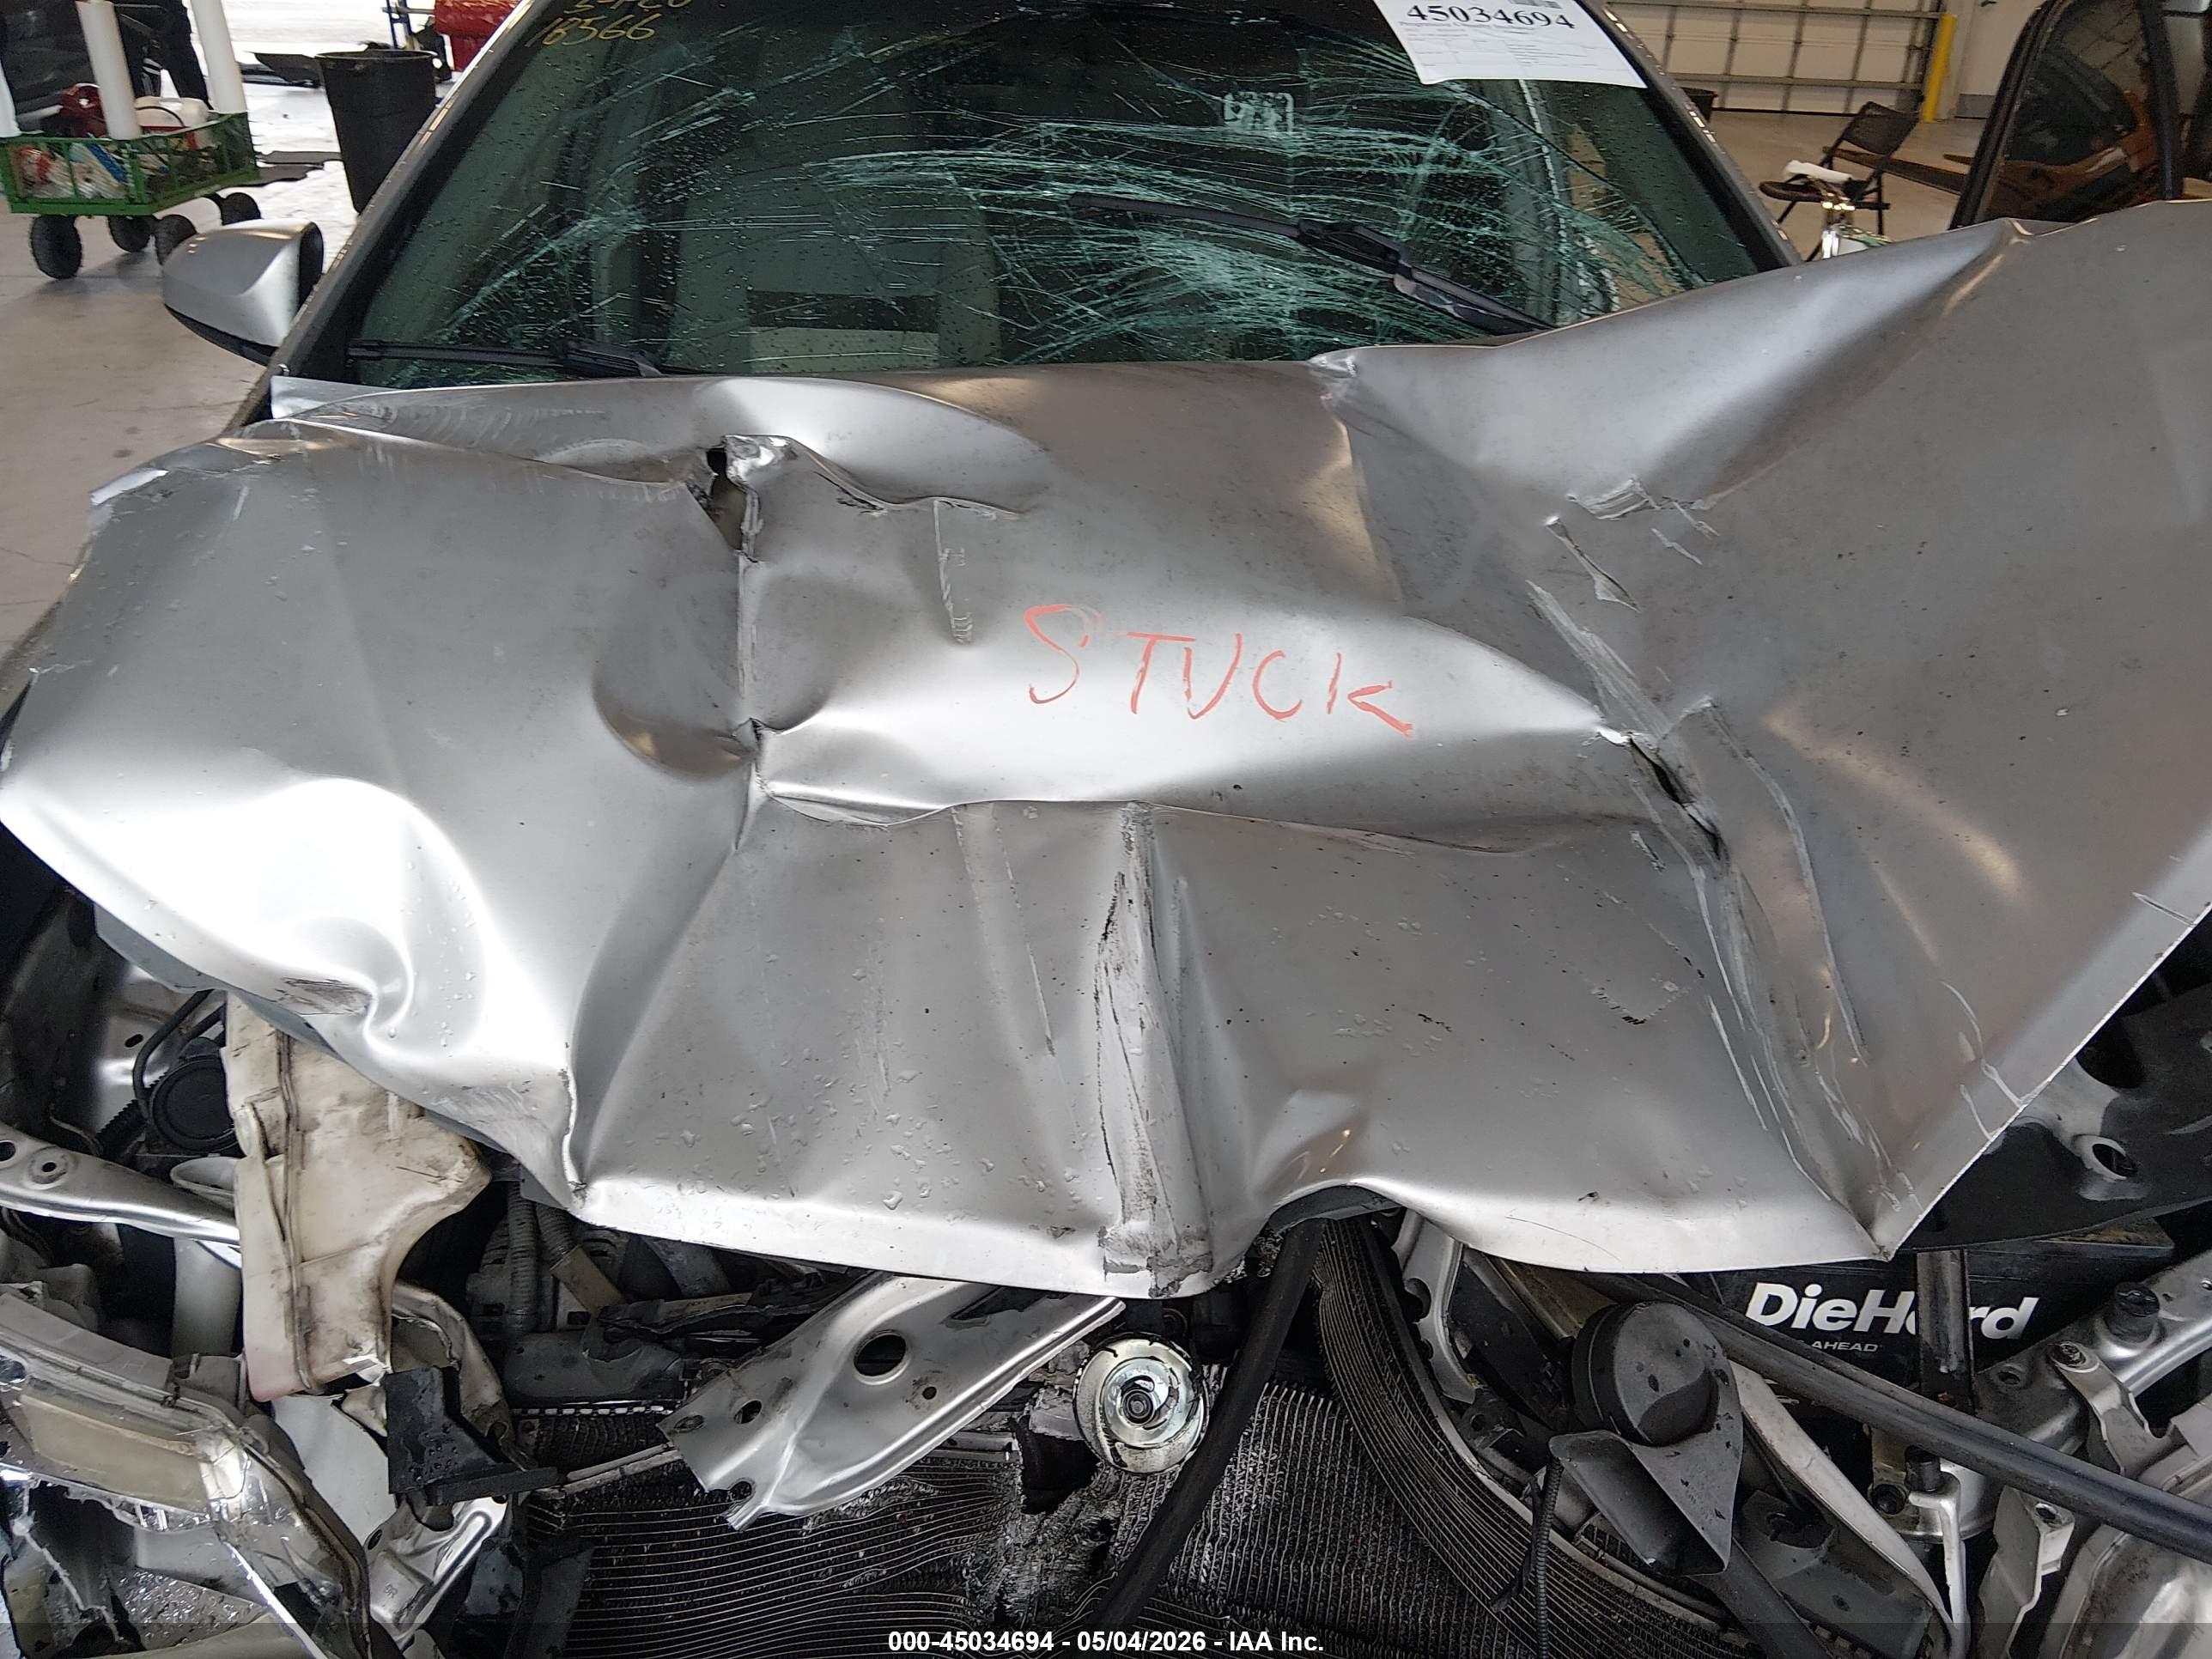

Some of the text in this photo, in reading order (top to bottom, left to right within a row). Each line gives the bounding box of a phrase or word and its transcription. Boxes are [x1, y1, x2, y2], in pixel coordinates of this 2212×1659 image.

[1407, 4, 1576, 30] 45034694
[1024, 603, 1415, 740] STUCK
[1746, 1282, 2040, 1340] DieHrd
[1811, 1340, 1879, 1353] AHEAD
